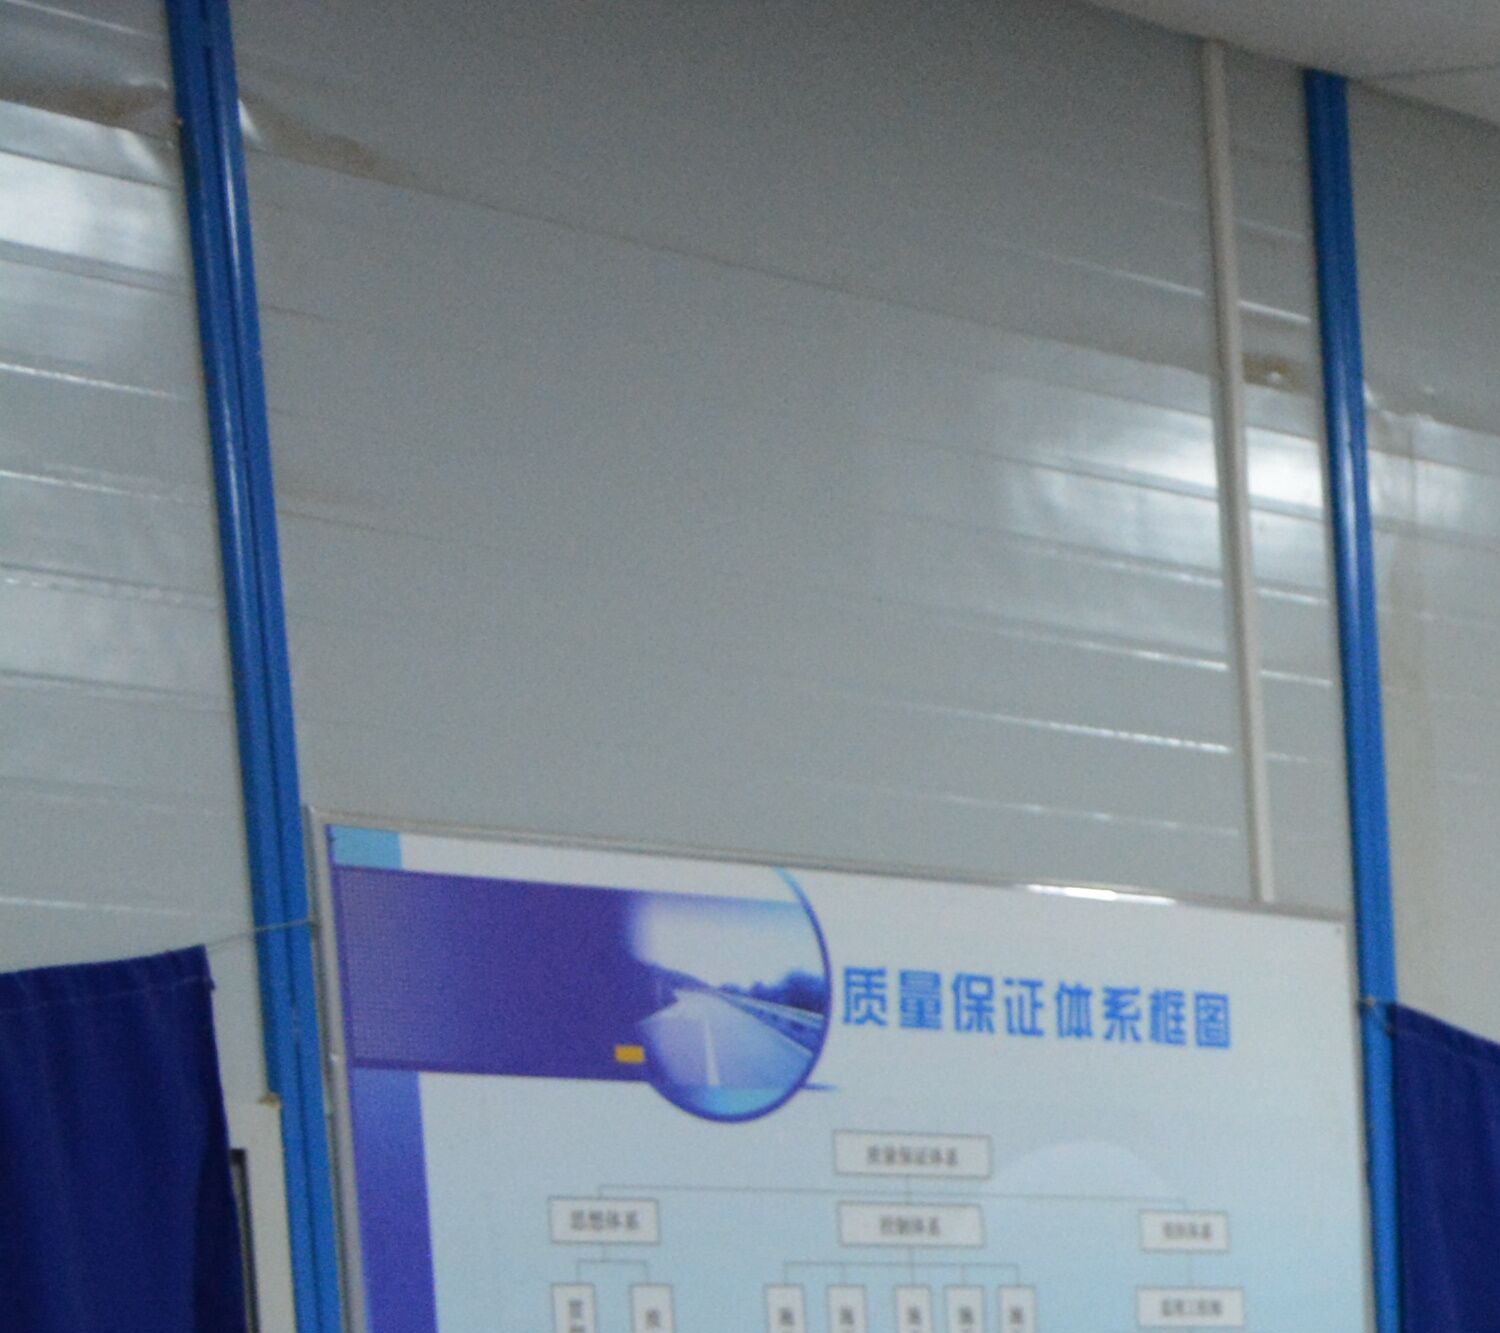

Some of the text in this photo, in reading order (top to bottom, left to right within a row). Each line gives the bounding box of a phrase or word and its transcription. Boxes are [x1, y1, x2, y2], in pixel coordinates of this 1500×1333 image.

[842, 965, 1231, 1049] 质量保证体系框图
